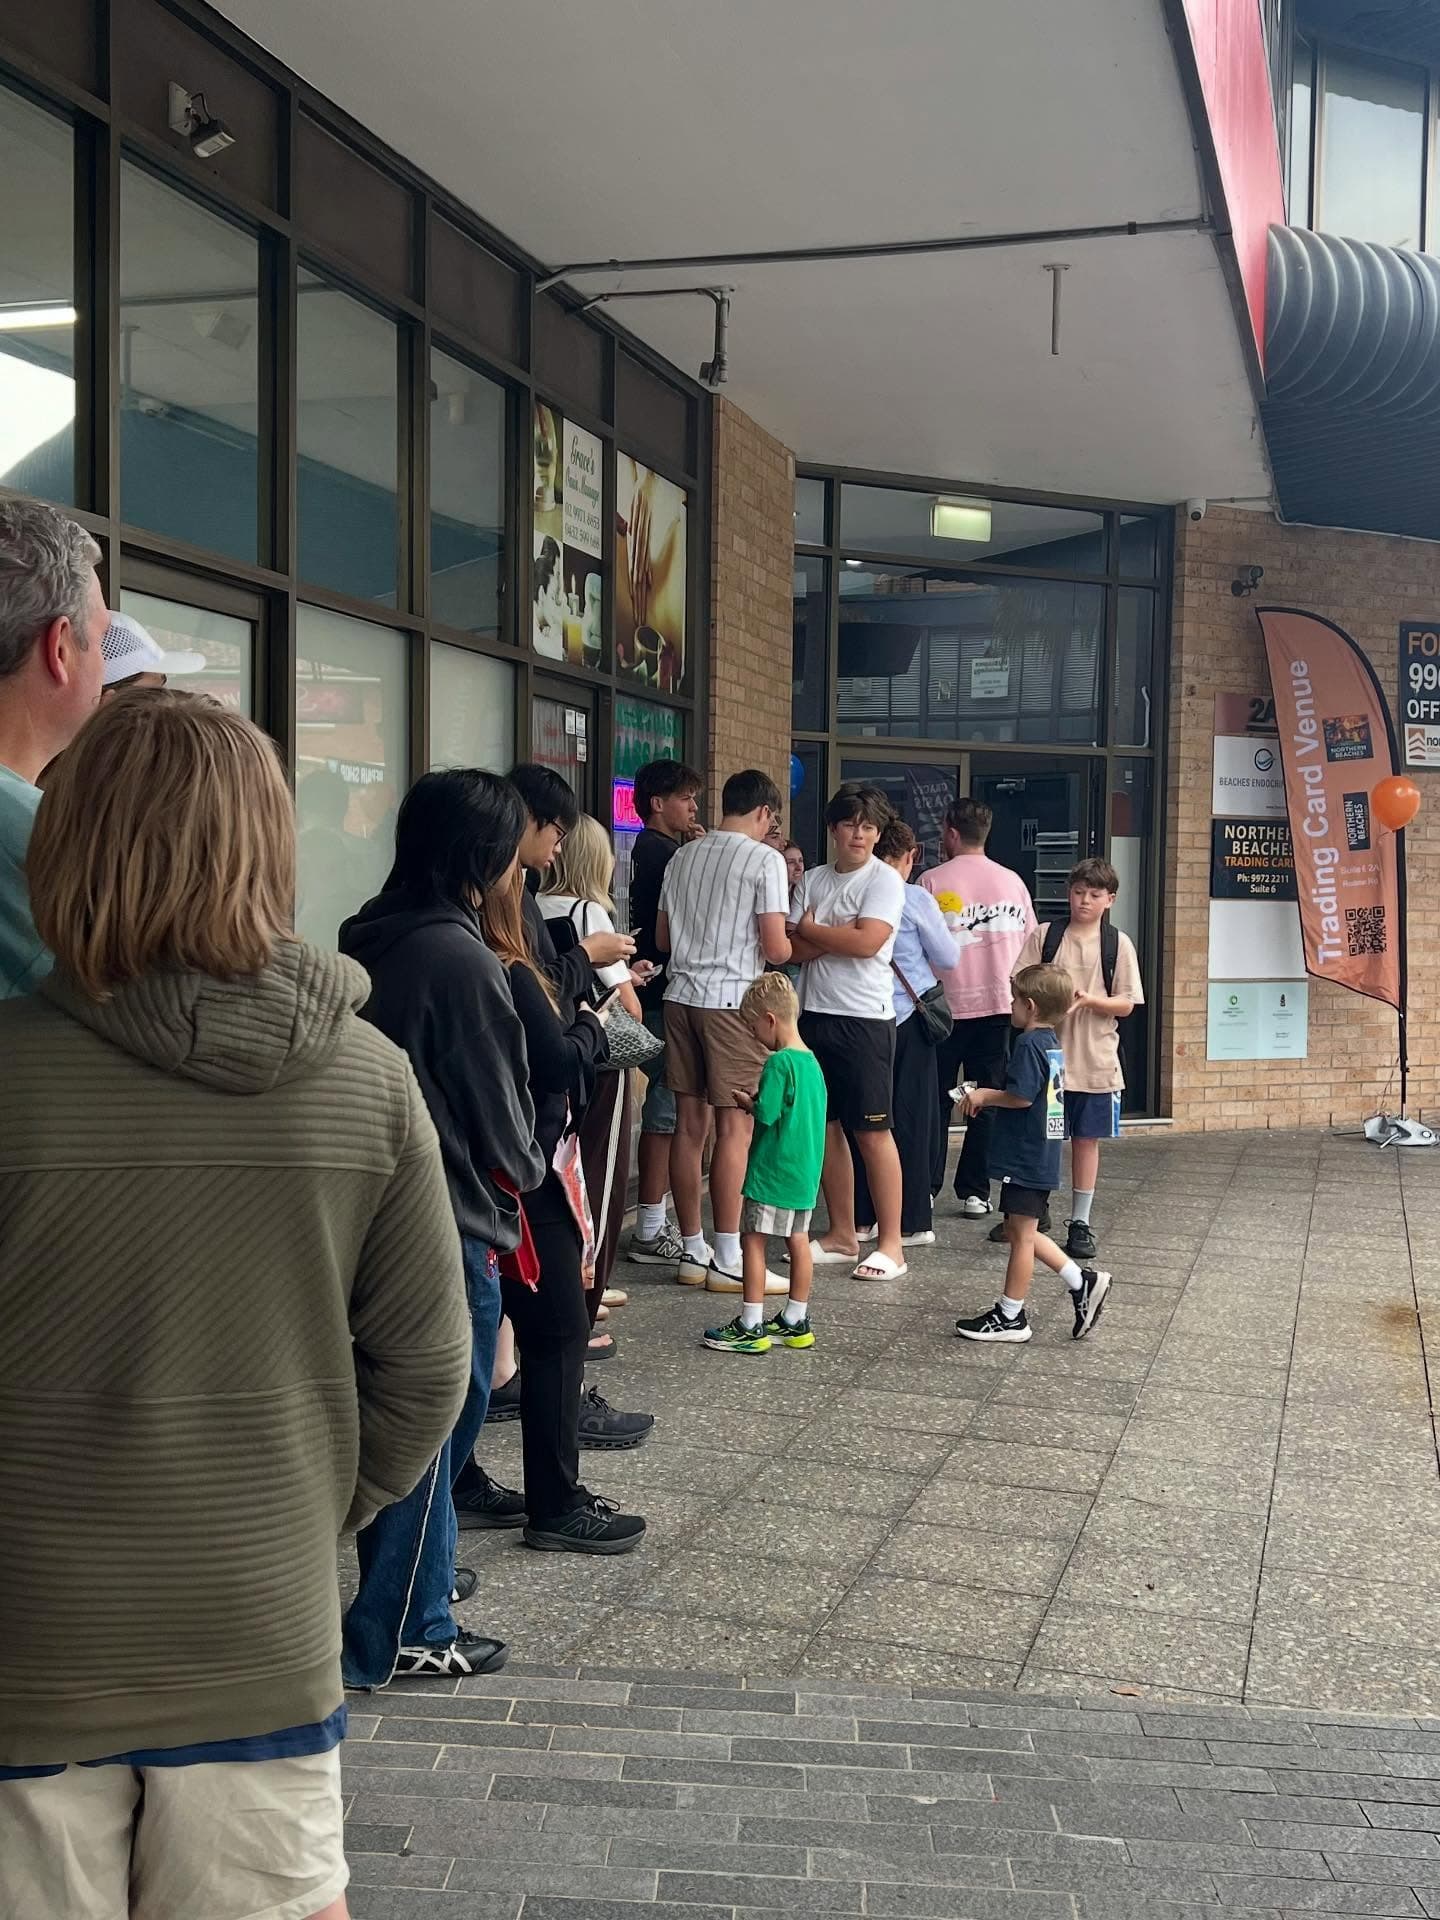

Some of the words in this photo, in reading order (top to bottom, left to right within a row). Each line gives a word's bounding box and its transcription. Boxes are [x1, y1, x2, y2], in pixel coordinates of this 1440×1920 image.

[1408, 631, 1440, 656] FO
[1409, 662, 1440, 694] 99
[1290, 659, 1319, 757] Venue
[1219, 776, 1250, 787] BEACHES
[1296, 765, 1328, 837] Card
[1345, 800, 1358, 846] NORTHERN
[1354, 803, 1366, 840] BEACHES
[1224, 855, 1269, 868] TRADING
[1236, 873, 1251, 883] Ph:
[1251, 873, 1270, 884] 9972
[1270, 873, 1289, 884] 2211
[1250, 884, 1270, 894] Suite
[1270, 885, 1277, 894] 6
[1311, 847, 1342, 964] Trading
